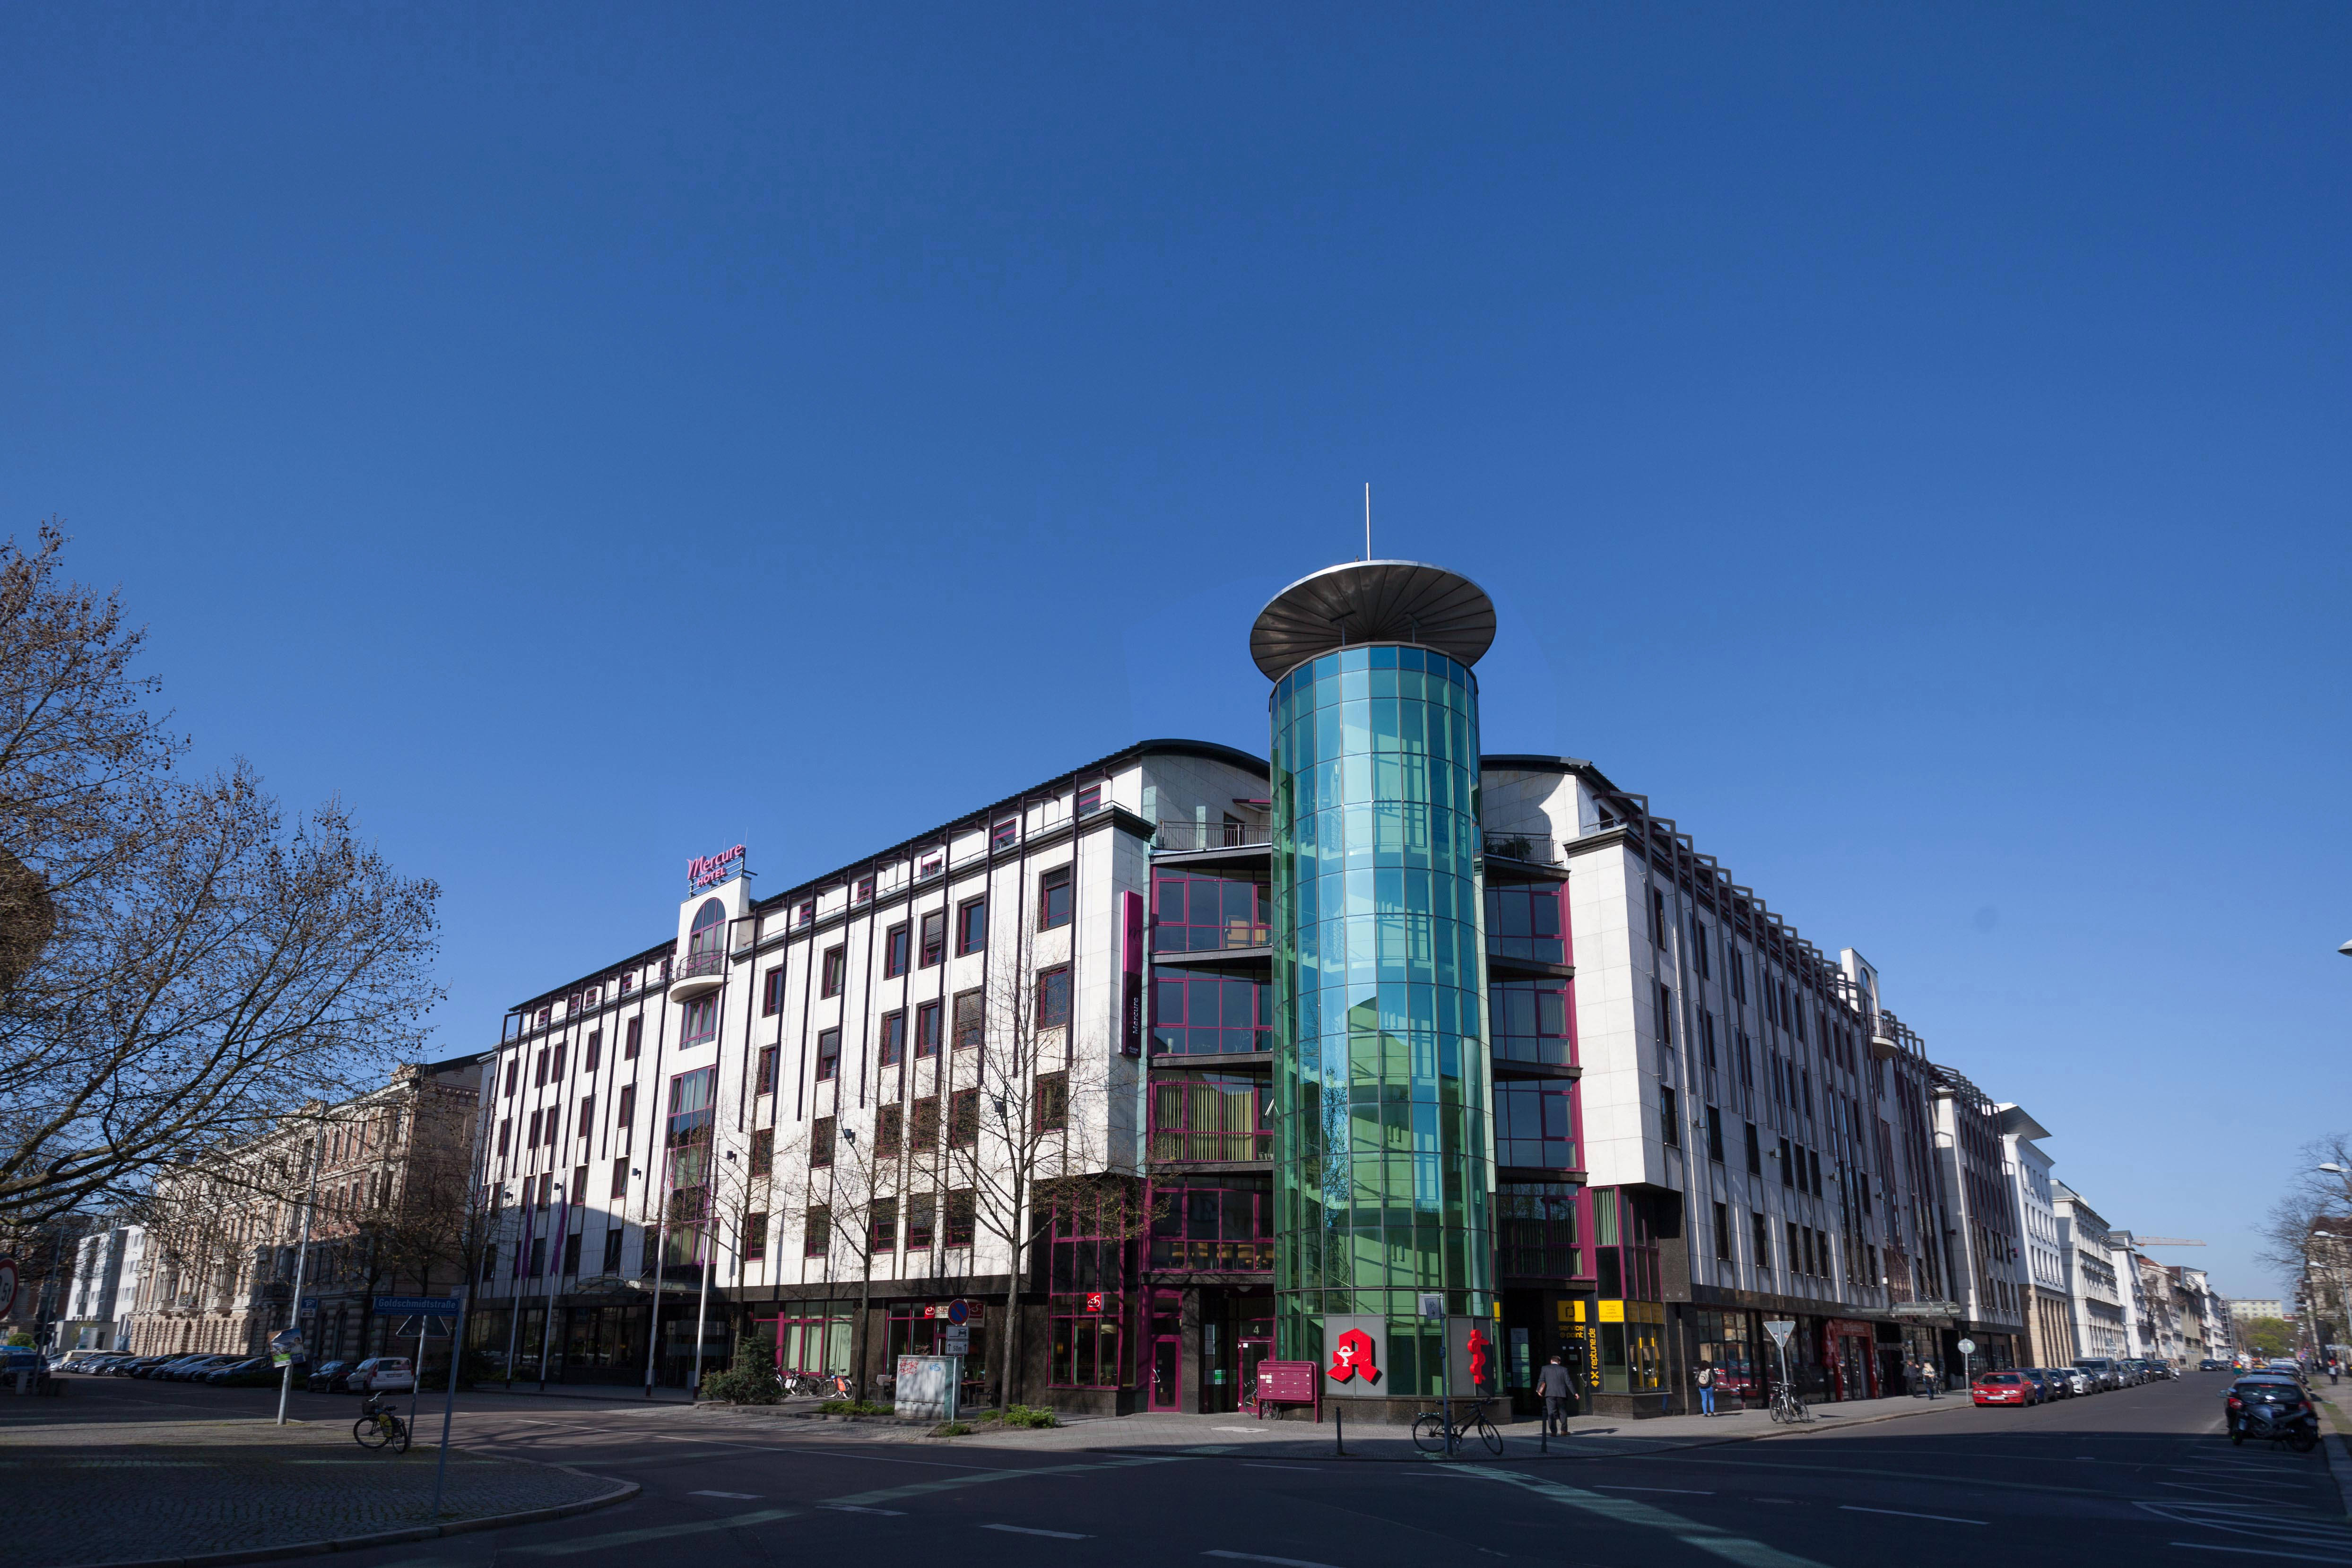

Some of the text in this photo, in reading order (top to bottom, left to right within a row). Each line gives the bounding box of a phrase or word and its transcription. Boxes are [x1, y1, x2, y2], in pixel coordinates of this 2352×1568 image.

[686, 844, 744, 880] Mercure
[697, 866, 727, 887] HOTEL
[378, 1298, 456, 1308] Goldschmidtstraße
[1253, 1325, 1259, 1335] 4
[1588, 1328, 1598, 1369] reptune.de
